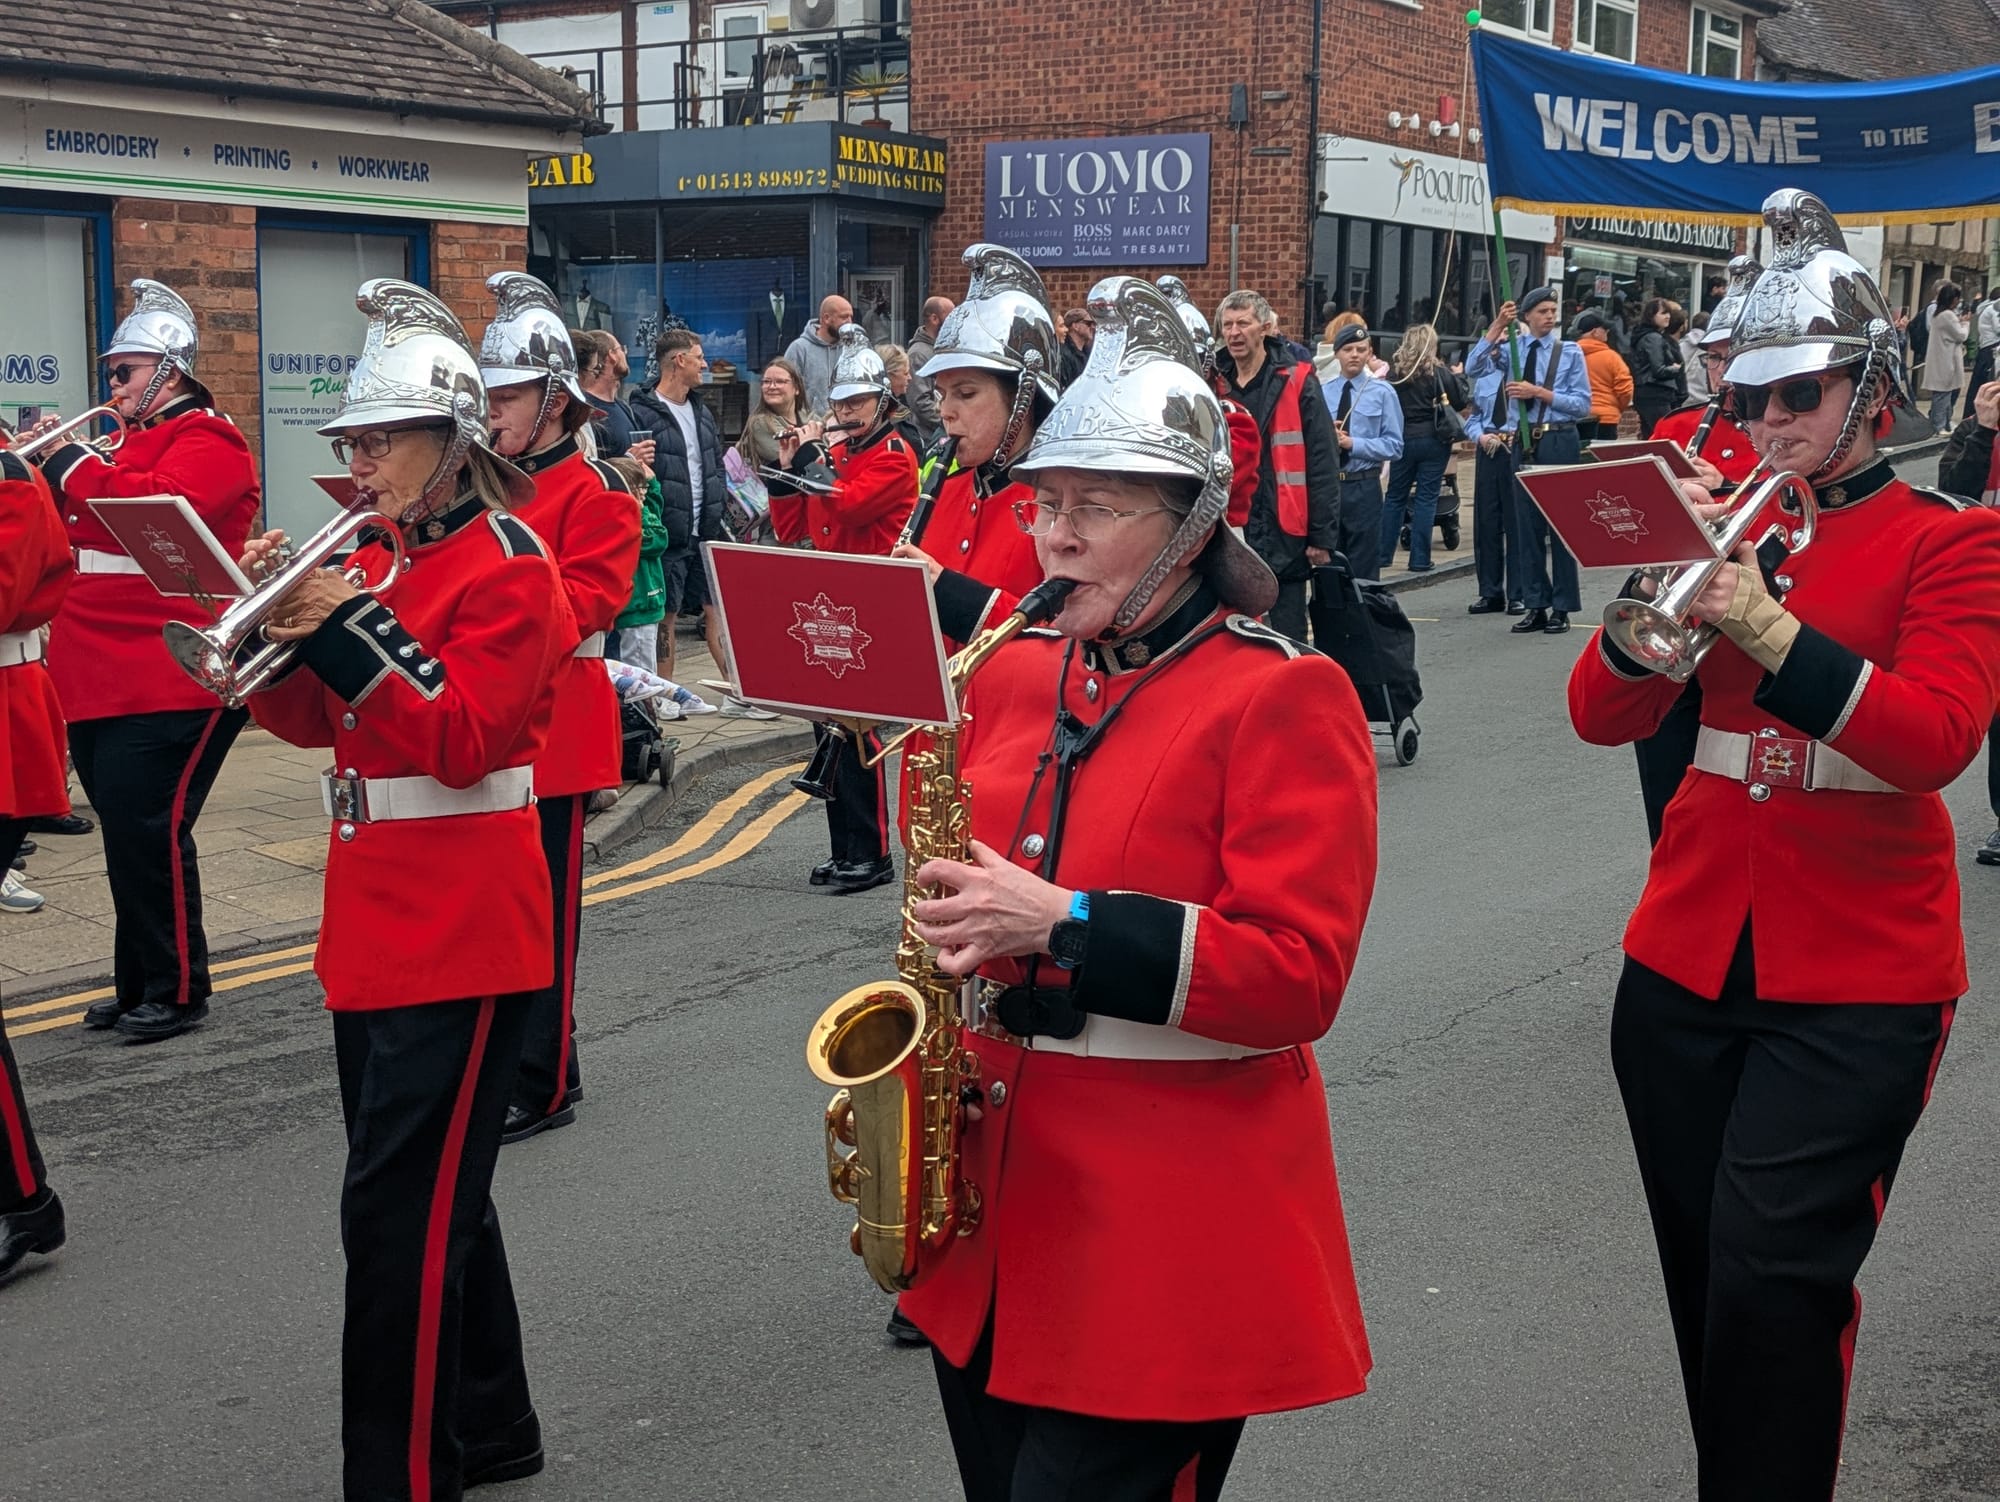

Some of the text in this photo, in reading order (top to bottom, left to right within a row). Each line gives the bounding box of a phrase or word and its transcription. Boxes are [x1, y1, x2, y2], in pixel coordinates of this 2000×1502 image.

[1534, 93, 1821, 164] WELCOME
[1860, 128, 1886, 148] TO
[1889, 126, 1928, 146] THE
[45, 128, 159, 160] EMBROIDERY
[214, 143, 291, 171] PRINTING
[838, 135, 946, 174] MENSWEAR
[338, 155, 430, 183] WORKWEAR
[696, 171, 752, 191] 01543
[757, 168, 828, 188] 898972
[836, 164, 901, 189] WEDDING
[903, 174, 944, 194] SUITS
[999, 147, 1193, 198] L'UOMO
[1413, 166, 1485, 206] POQUITO
[998, 195, 1193, 218] MENSWEAR
[1073, 223, 1113, 238] BOSS
[1122, 224, 1191, 237] MARC DARCY
[1637, 220, 1682, 243] SPIKES
[1682, 224, 1730, 251] BARBER
[1032, 246, 1063, 257] UOMO
[1122, 243, 1191, 255] TRESANTI
[267, 407, 337, 415] ALWAYS OPEN FOR
